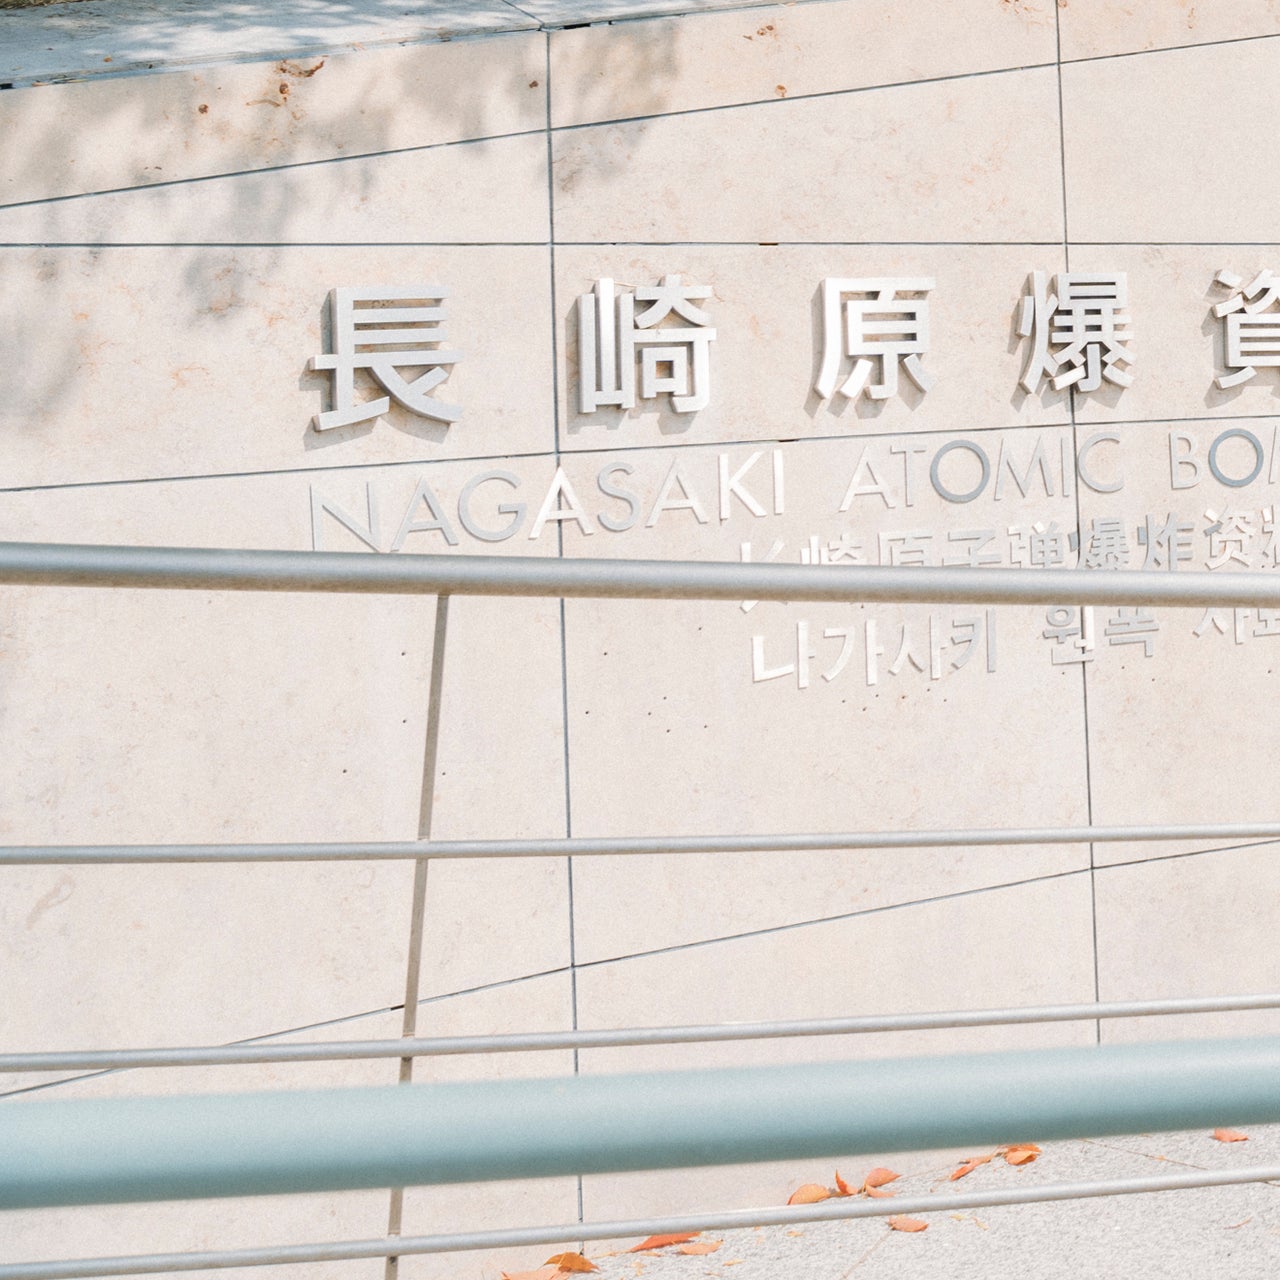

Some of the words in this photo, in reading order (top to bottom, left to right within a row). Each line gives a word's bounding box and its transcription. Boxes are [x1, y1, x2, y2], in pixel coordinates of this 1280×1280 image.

[309, 448, 786, 552] NAGASAKI
[838, 431, 1124, 513] ATOMIC
[752, 608, 996, 690] 나가사키
